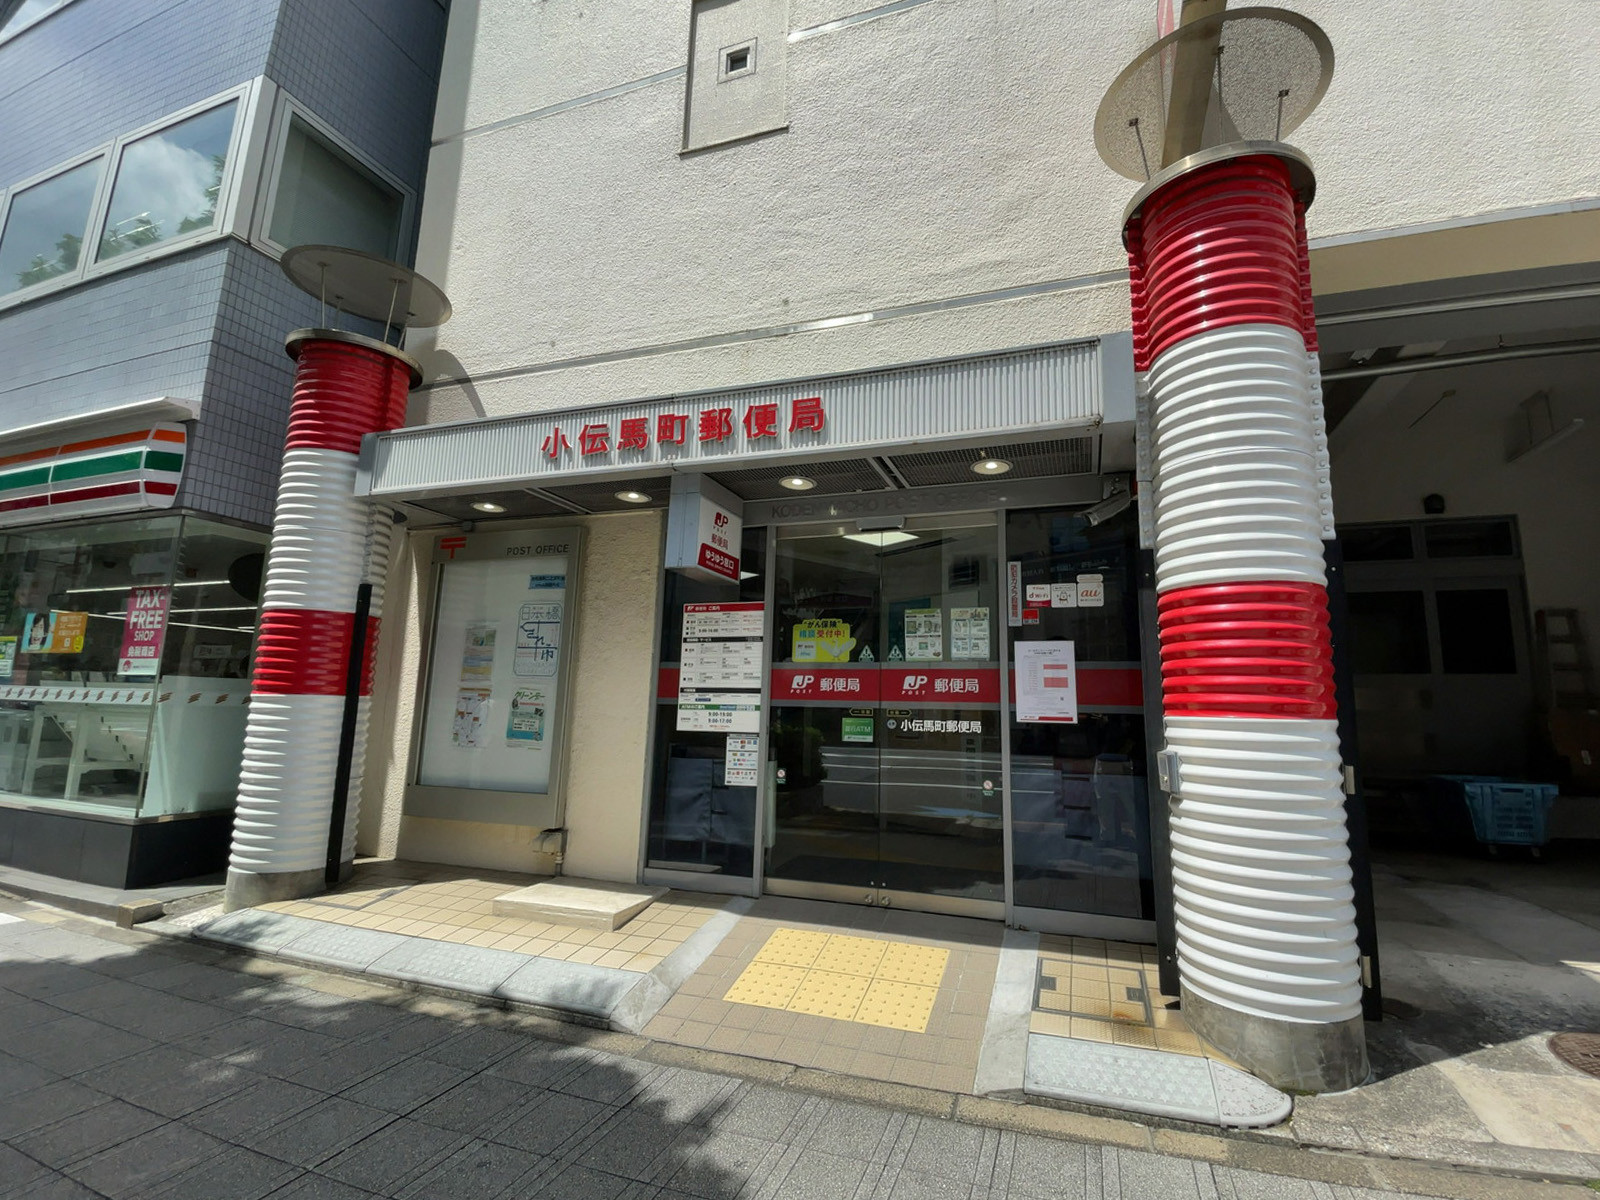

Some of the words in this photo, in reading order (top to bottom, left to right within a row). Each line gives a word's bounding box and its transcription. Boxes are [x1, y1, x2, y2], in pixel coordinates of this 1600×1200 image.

[541, 397, 826, 459] 小伝馬町郵便局
[711, 533, 729, 550] 郵便局
[507, 546, 531, 556] POST
[535, 544, 569, 554] OFFICE
[705, 549, 734, 569] ゆうゆう窓口
[135, 589, 165, 608] TAX-
[1081, 589, 1100, 597] au
[129, 610, 164, 629] FREE
[133, 631, 155, 641] SHOP
[819, 678, 860, 692] 郵便局
[934, 679, 979, 693] 郵便局
[900, 719, 982, 734] 小伝馬町郵便局
